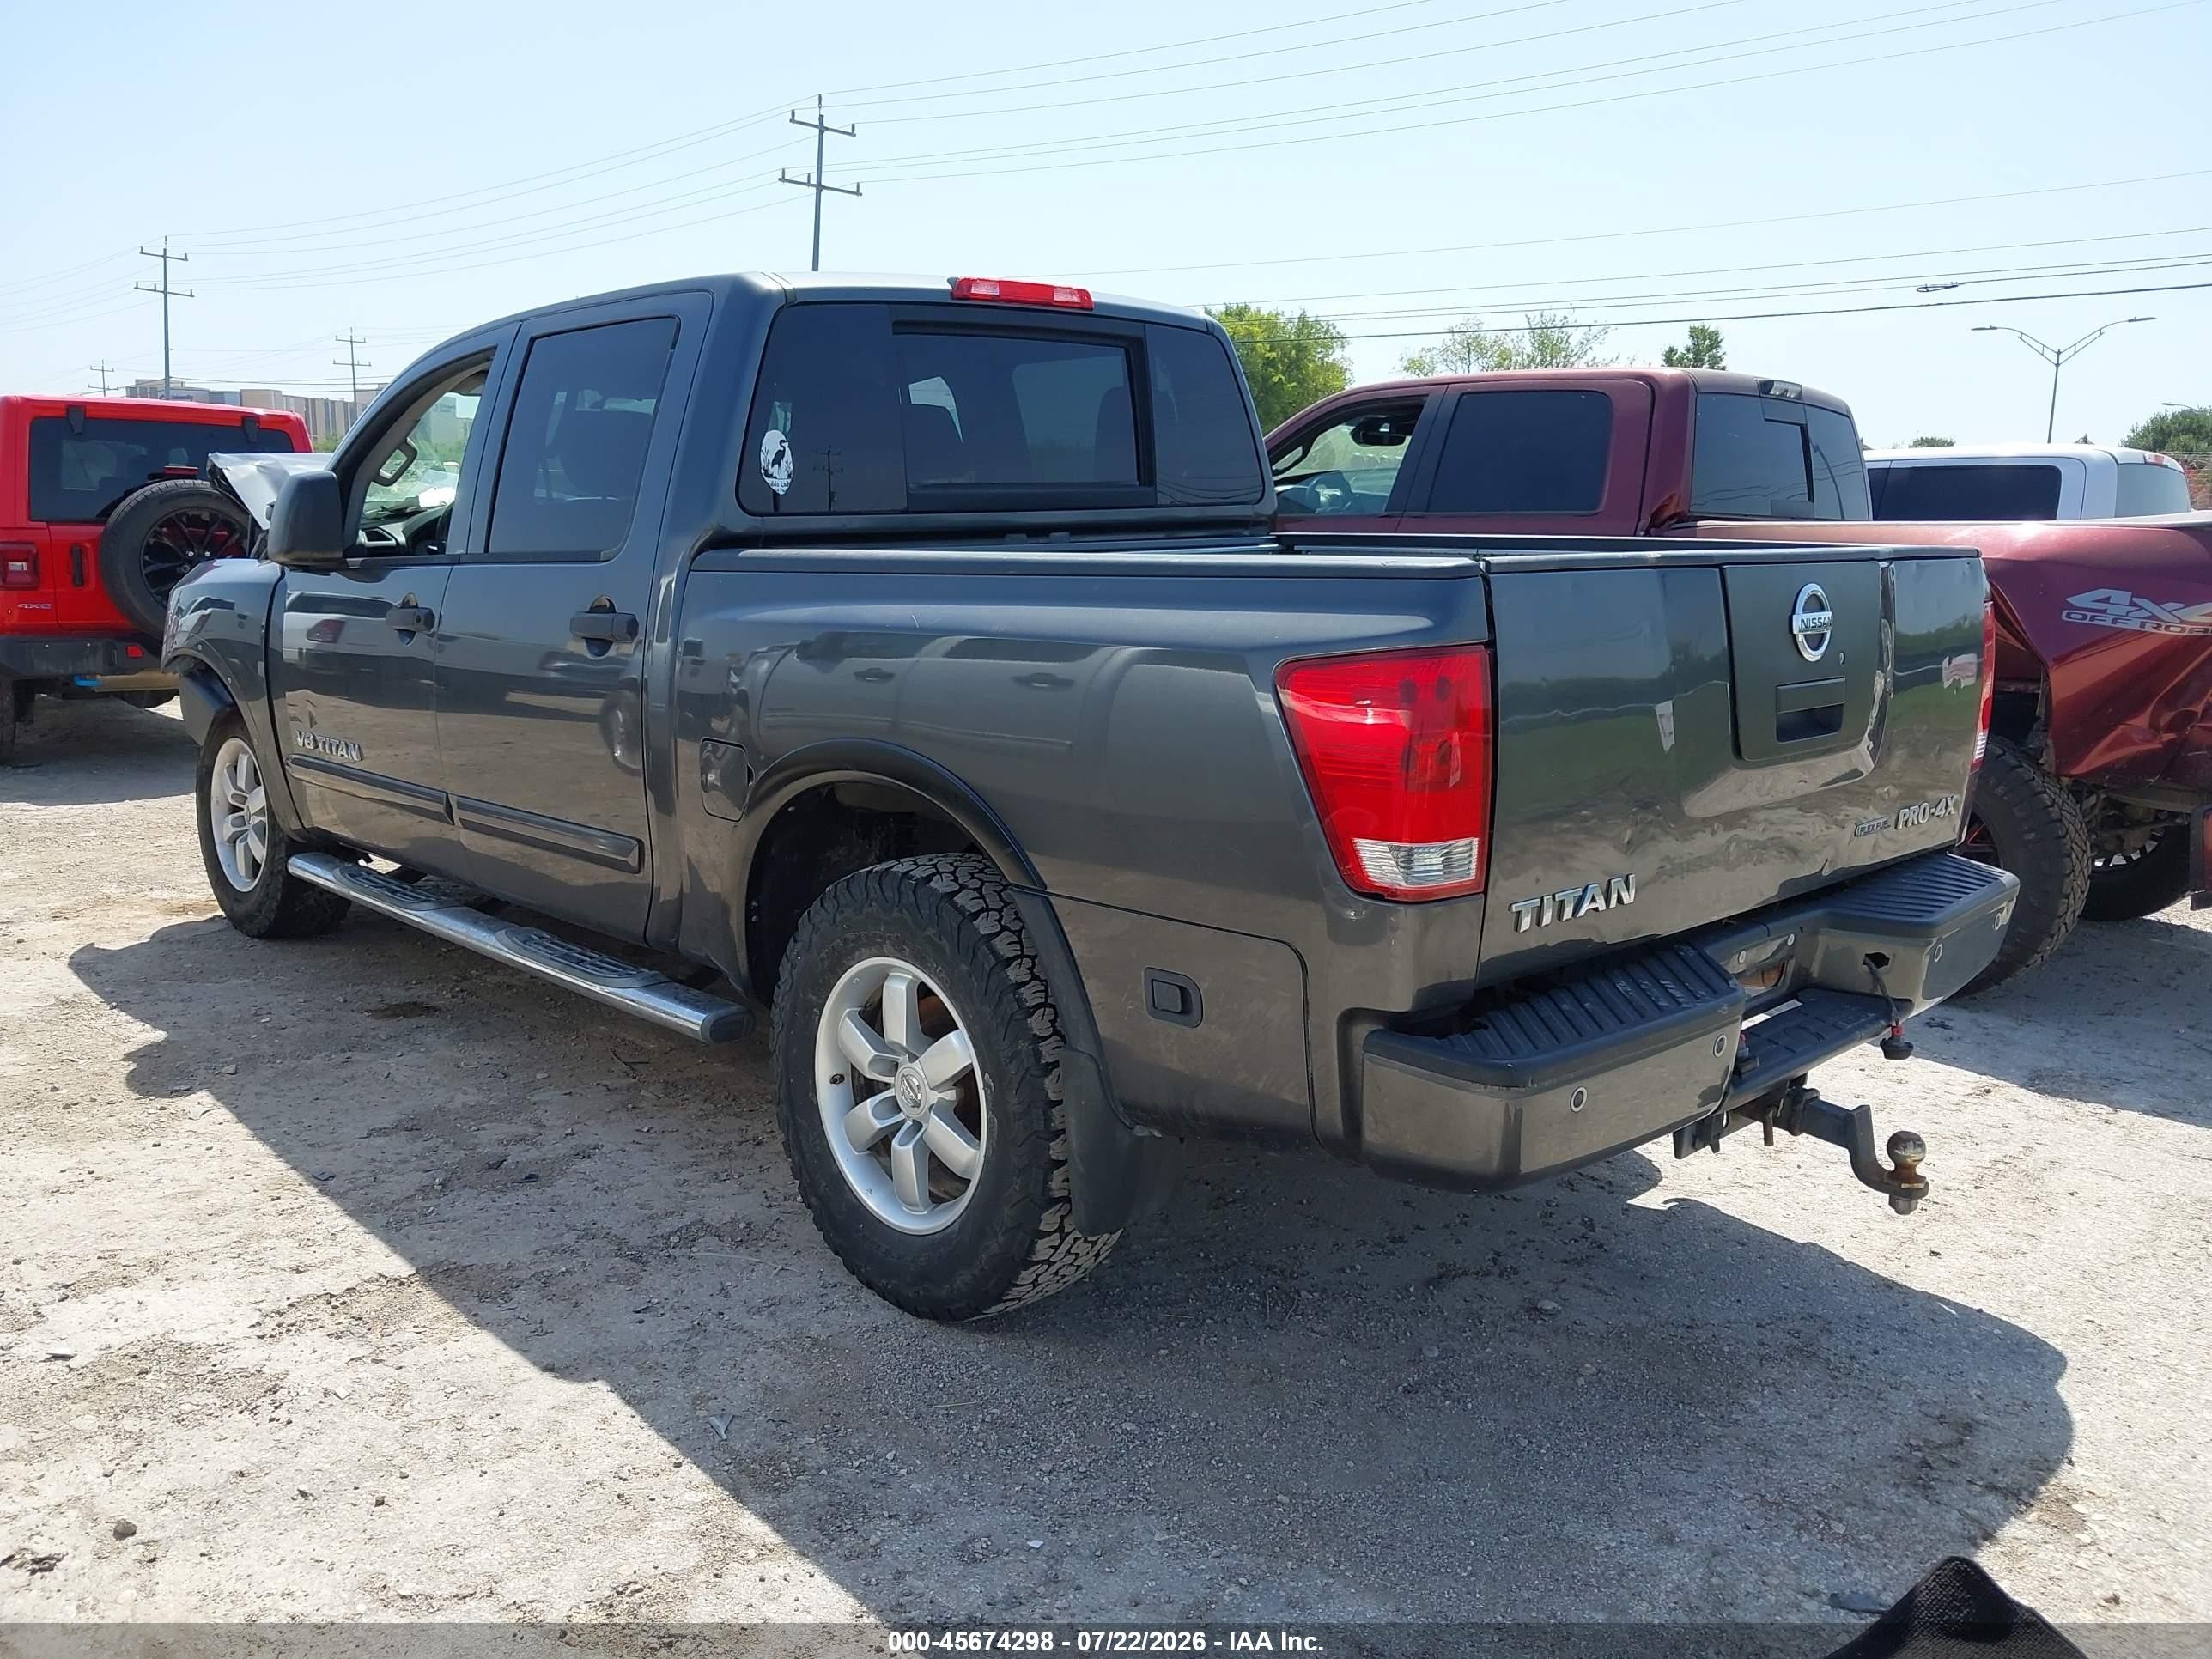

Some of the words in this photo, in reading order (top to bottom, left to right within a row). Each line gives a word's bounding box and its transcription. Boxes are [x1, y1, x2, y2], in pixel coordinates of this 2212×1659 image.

[1800, 617, 1832, 629] NISSAN
[2064, 611, 2133, 626] OFF
[2139, 619, 2212, 635] ROA
[295, 729, 319, 750] V8
[317, 735, 364, 763] TITAN
[1895, 795, 1959, 830] PRO-4X
[1509, 873, 1636, 933] TITAN
